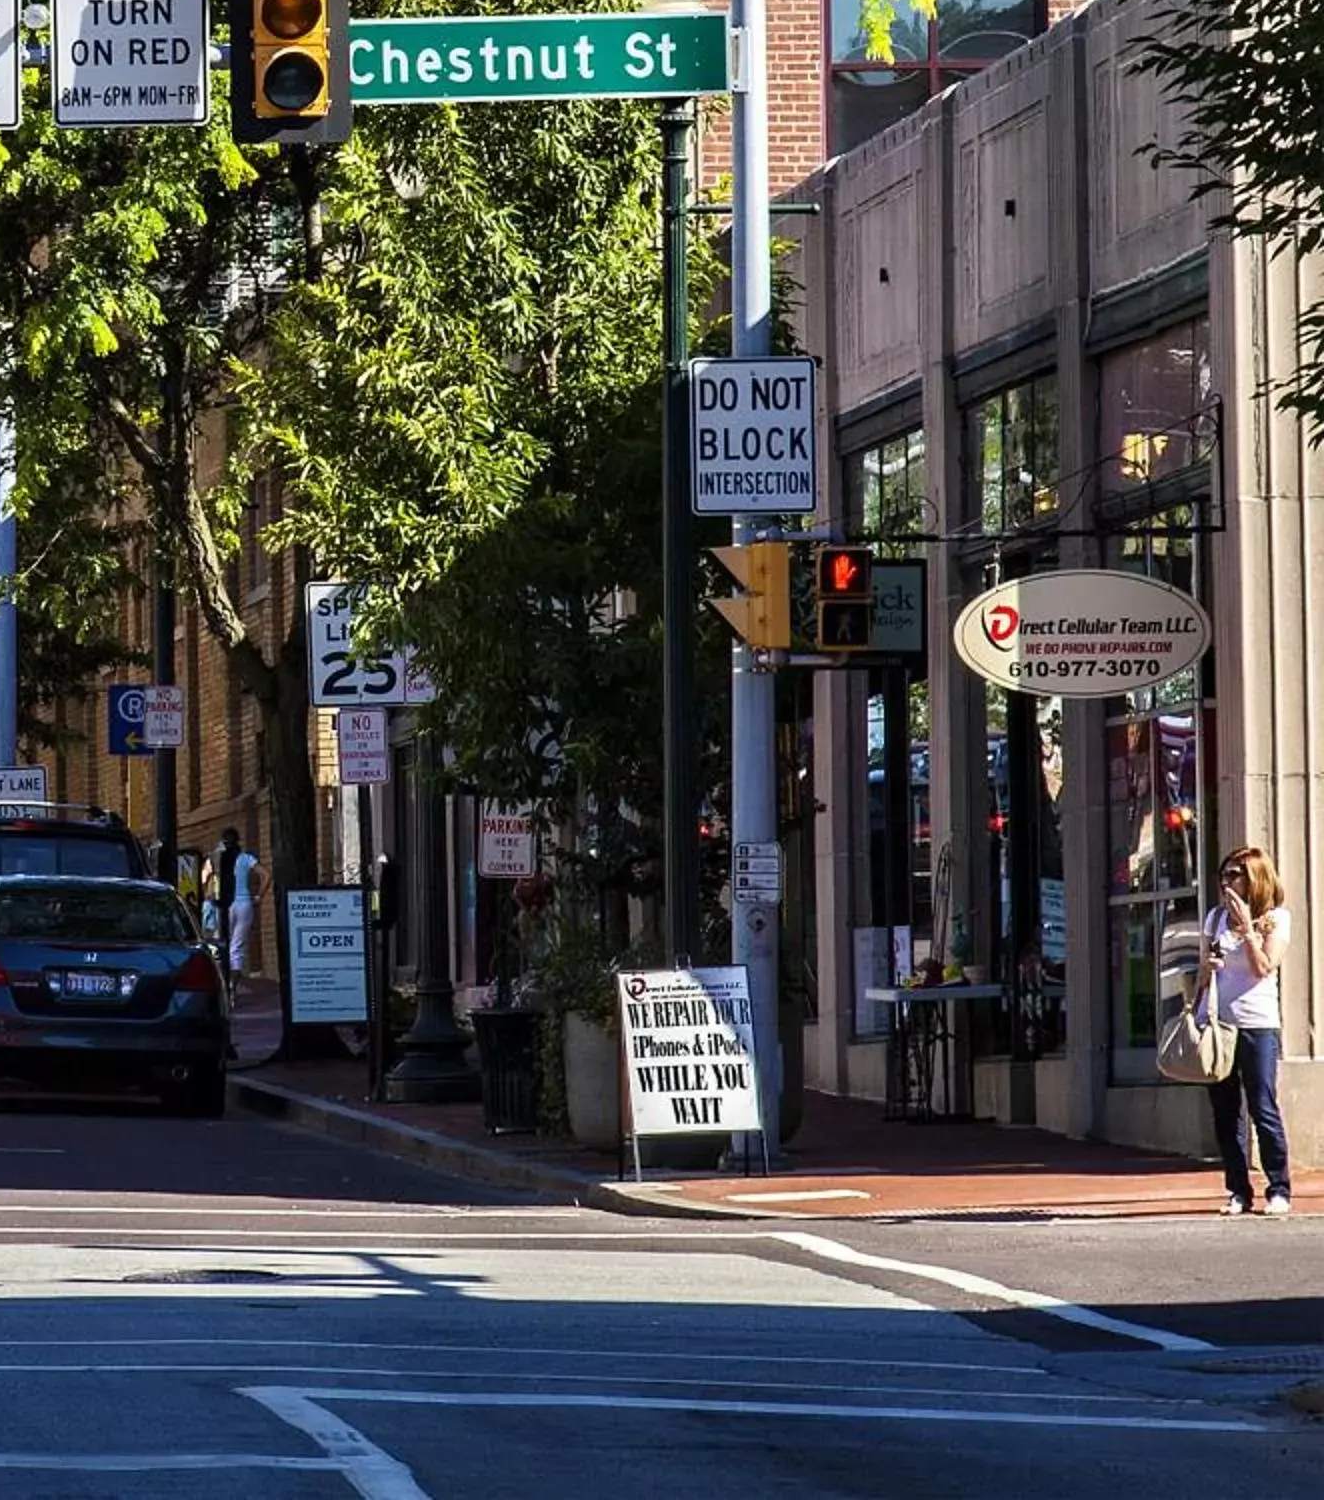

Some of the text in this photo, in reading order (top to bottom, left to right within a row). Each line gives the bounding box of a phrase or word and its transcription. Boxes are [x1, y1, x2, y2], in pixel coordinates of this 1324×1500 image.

[71, 37, 190, 66] ON RED
[349, 31, 677, 86] Chestnut St
[61, 86, 132, 107] 8AM-6PM
[699, 376, 807, 411] DO NOT
[699, 426, 809, 461] BLOCK
[699, 471, 810, 496] INTERSECTION
[1058, 617, 1117, 635] Cellular
[1120, 617, 1163, 634] Team
[321, 651, 398, 697] 25
[1009, 659, 1161, 678] 610-977-3070
[352, 715, 371, 731] NO
[9, 777, 41, 792] LANE
[309, 934, 355, 949] OPEN
[627, 997, 751, 1029] WE REPAIR YOUR
[633, 1032, 748, 1059] iPhones & iPods
[636, 1063, 750, 1093] WHILE YOU
[670, 1096, 723, 1125] WAIT
